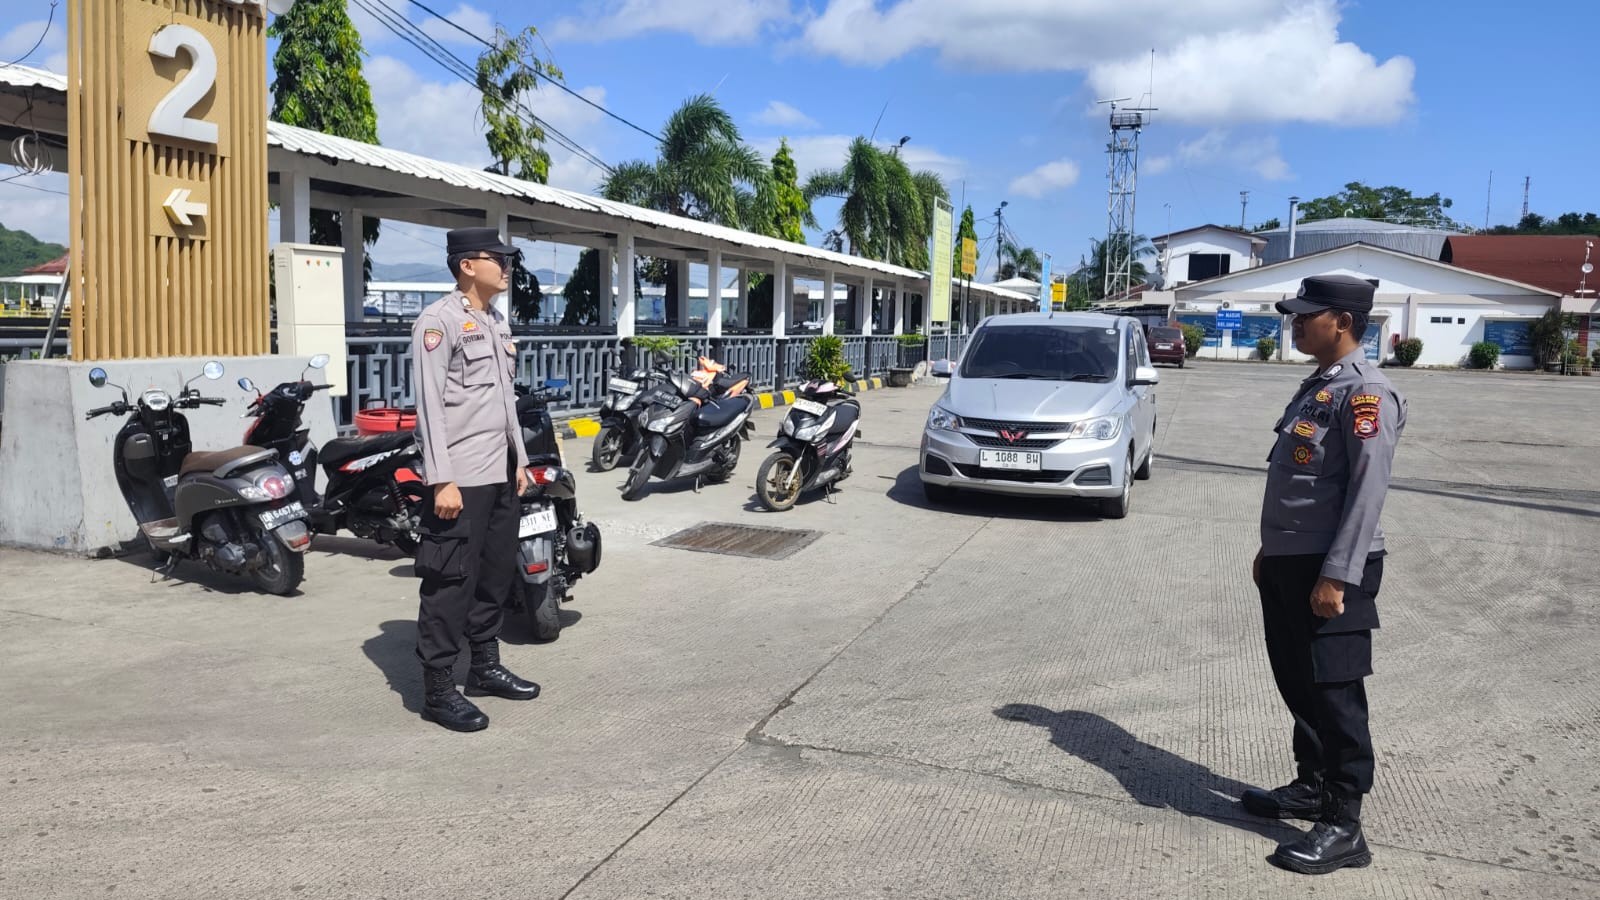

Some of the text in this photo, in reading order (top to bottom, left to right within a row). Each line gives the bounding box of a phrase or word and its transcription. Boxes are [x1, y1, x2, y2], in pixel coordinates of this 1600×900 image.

[148, 24, 219, 144] 2
[982, 451, 1038, 464] L 1088 BW
